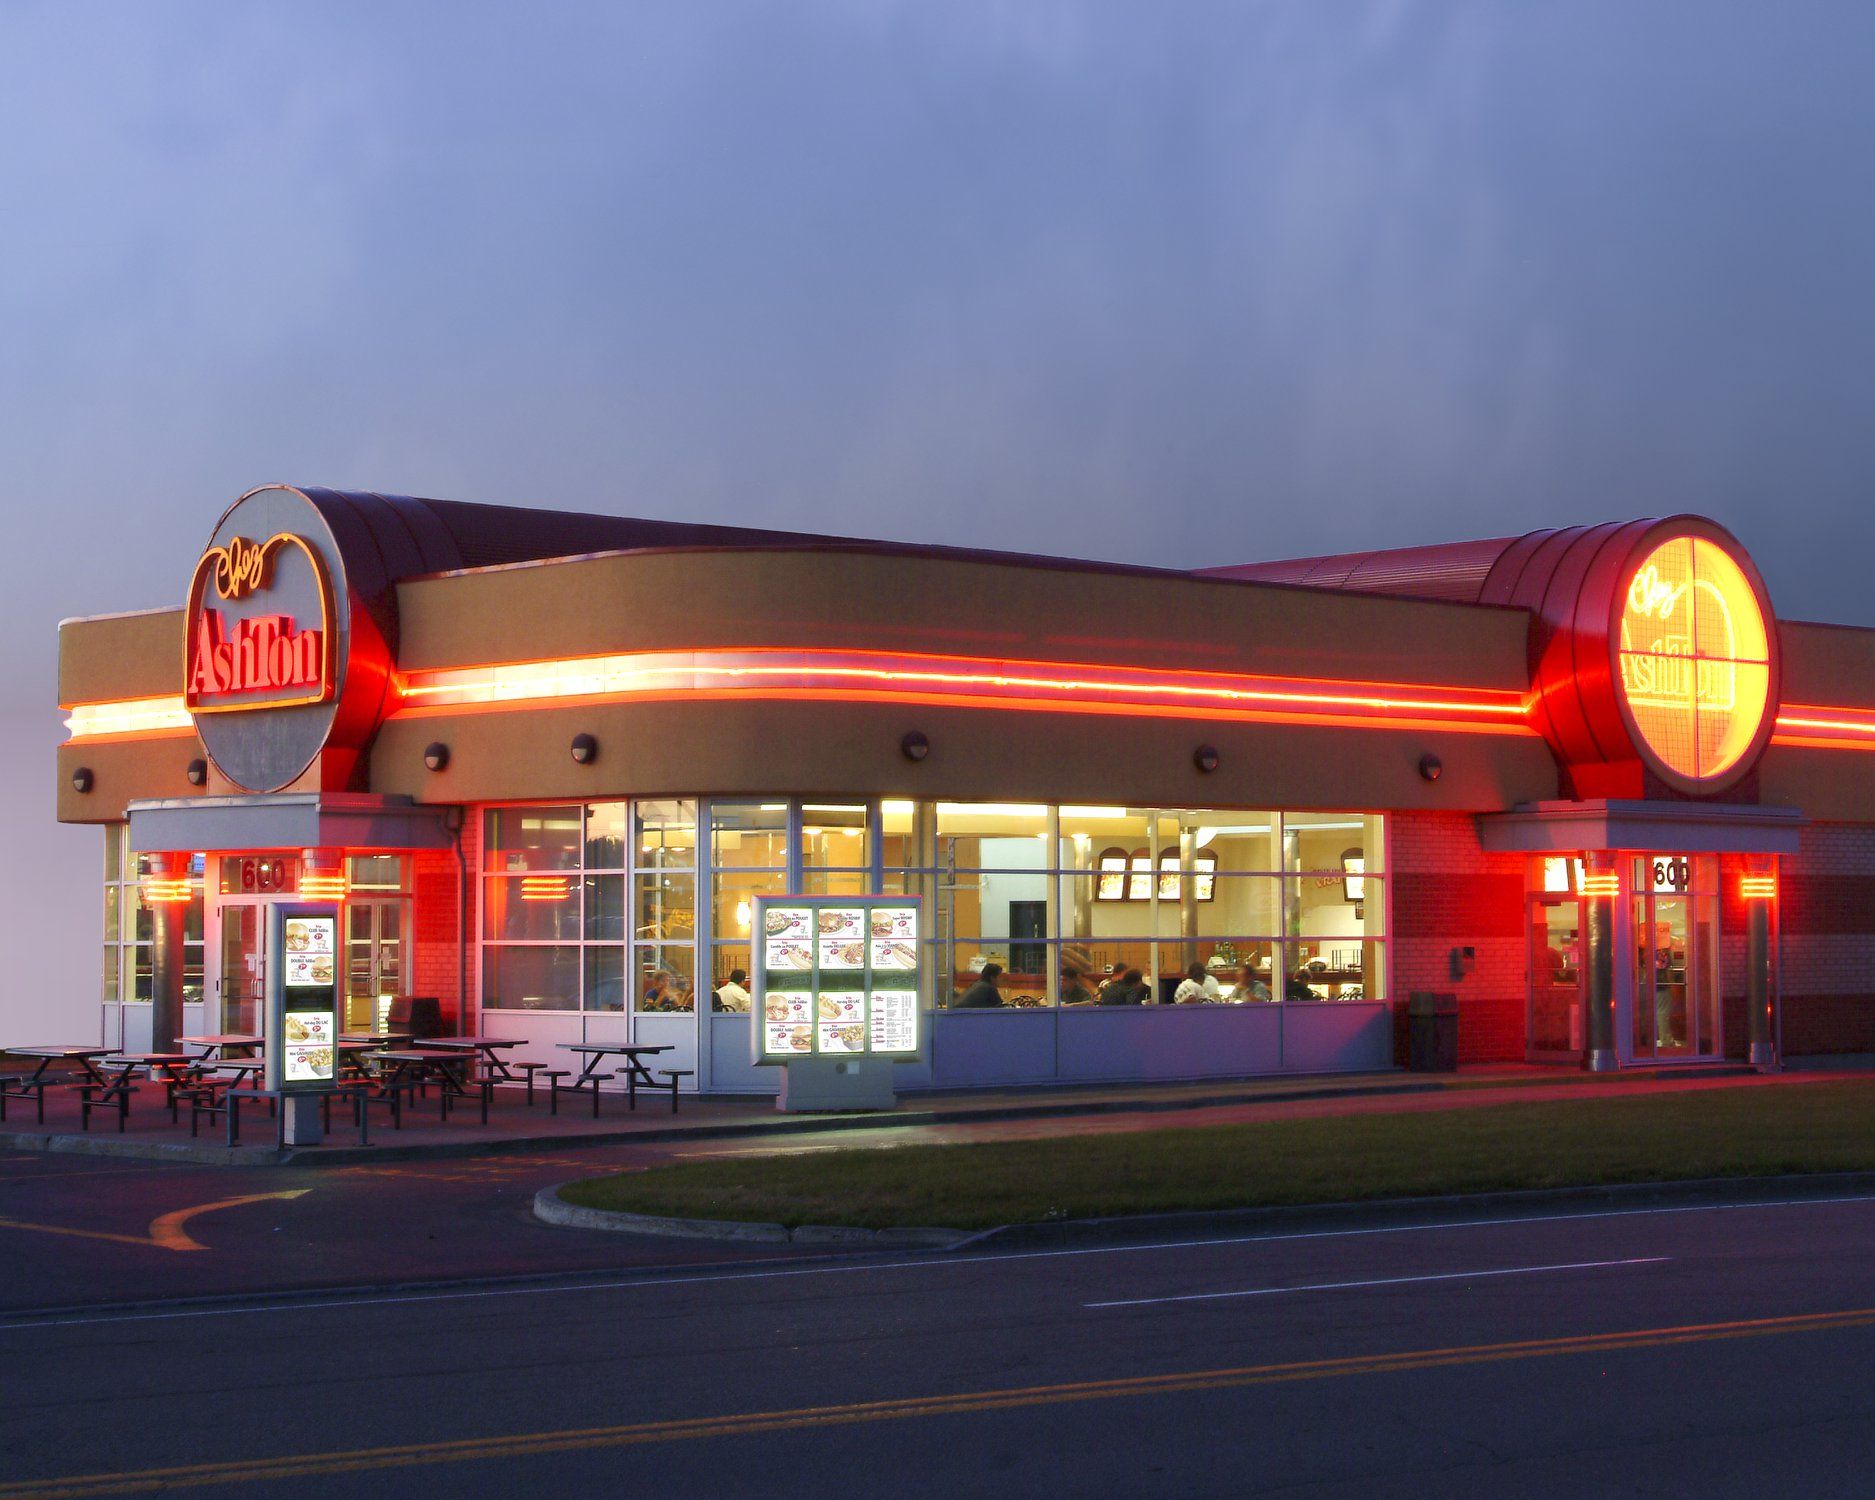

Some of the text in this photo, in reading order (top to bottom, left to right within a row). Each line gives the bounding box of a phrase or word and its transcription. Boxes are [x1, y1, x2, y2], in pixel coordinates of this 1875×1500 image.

[213, 536, 266, 600] Chez
[242, 860, 285, 889] 600
[1653, 861, 1691, 885] 600
